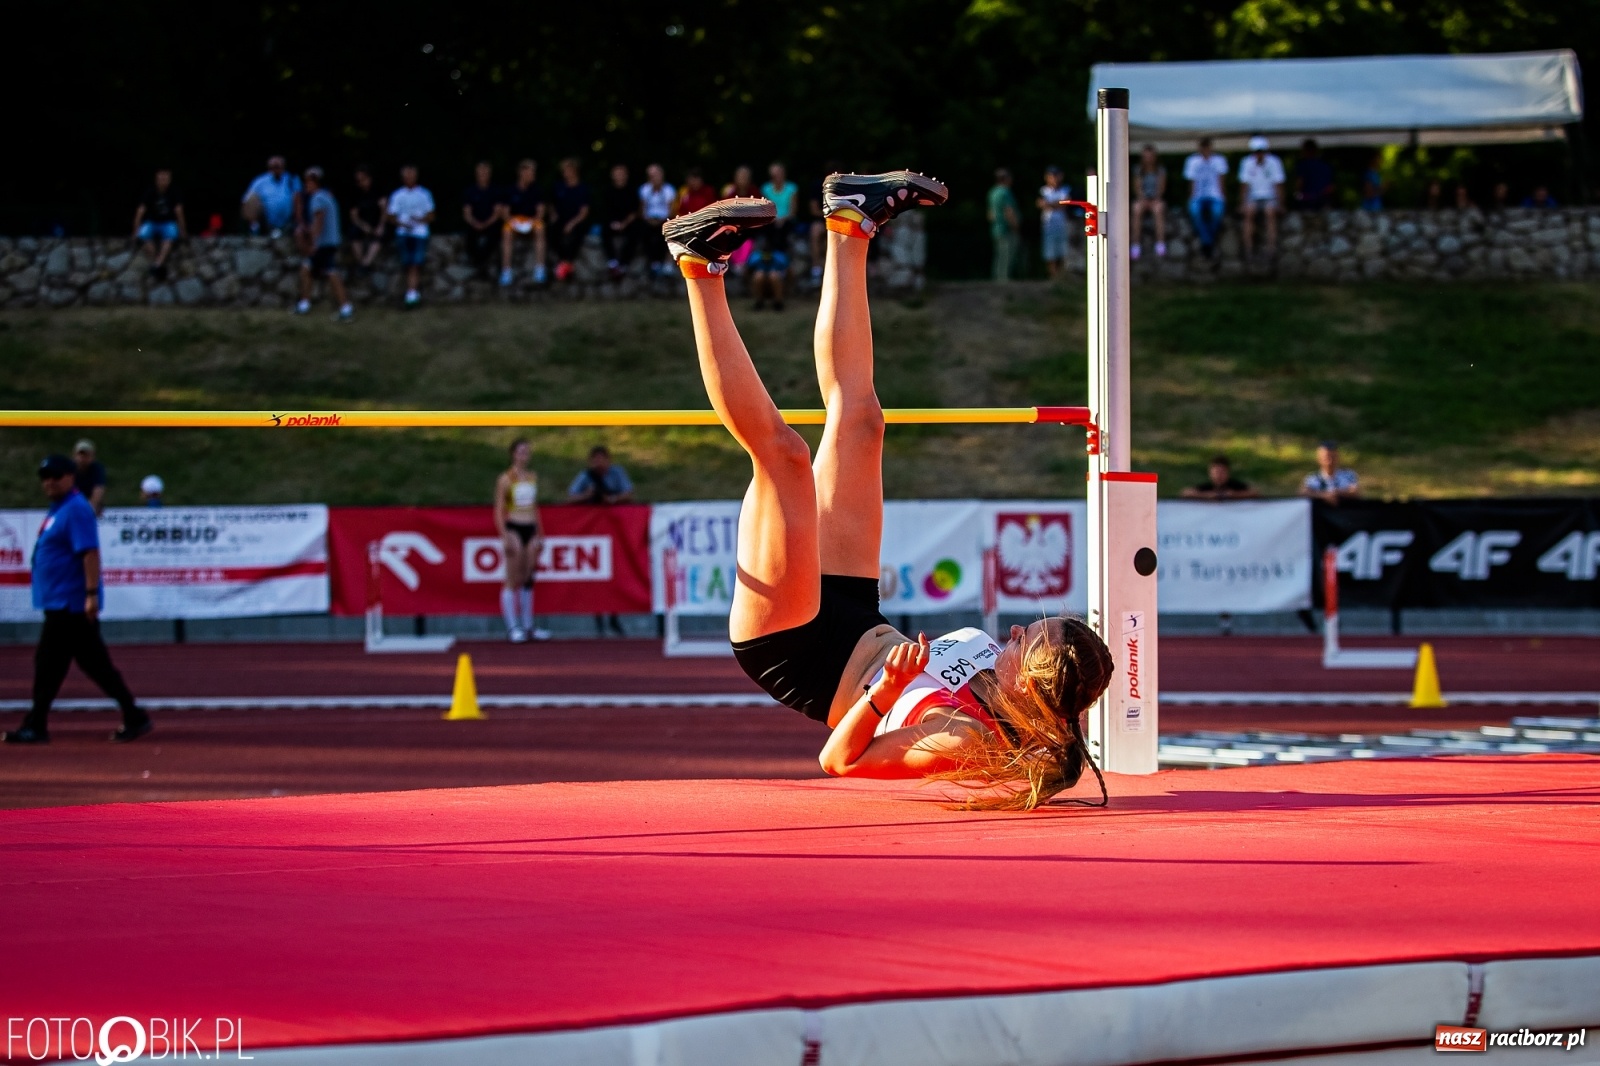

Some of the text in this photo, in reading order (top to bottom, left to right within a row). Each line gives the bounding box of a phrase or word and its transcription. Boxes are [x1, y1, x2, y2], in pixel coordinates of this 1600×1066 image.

[286, 413, 342, 427] polanik
[668, 516, 737, 555] NEST
[474, 546, 600, 573] OEN
[1428, 531, 1522, 580] 4F
[940, 658, 976, 686] 643
[1127, 637, 1141, 700] polanik
